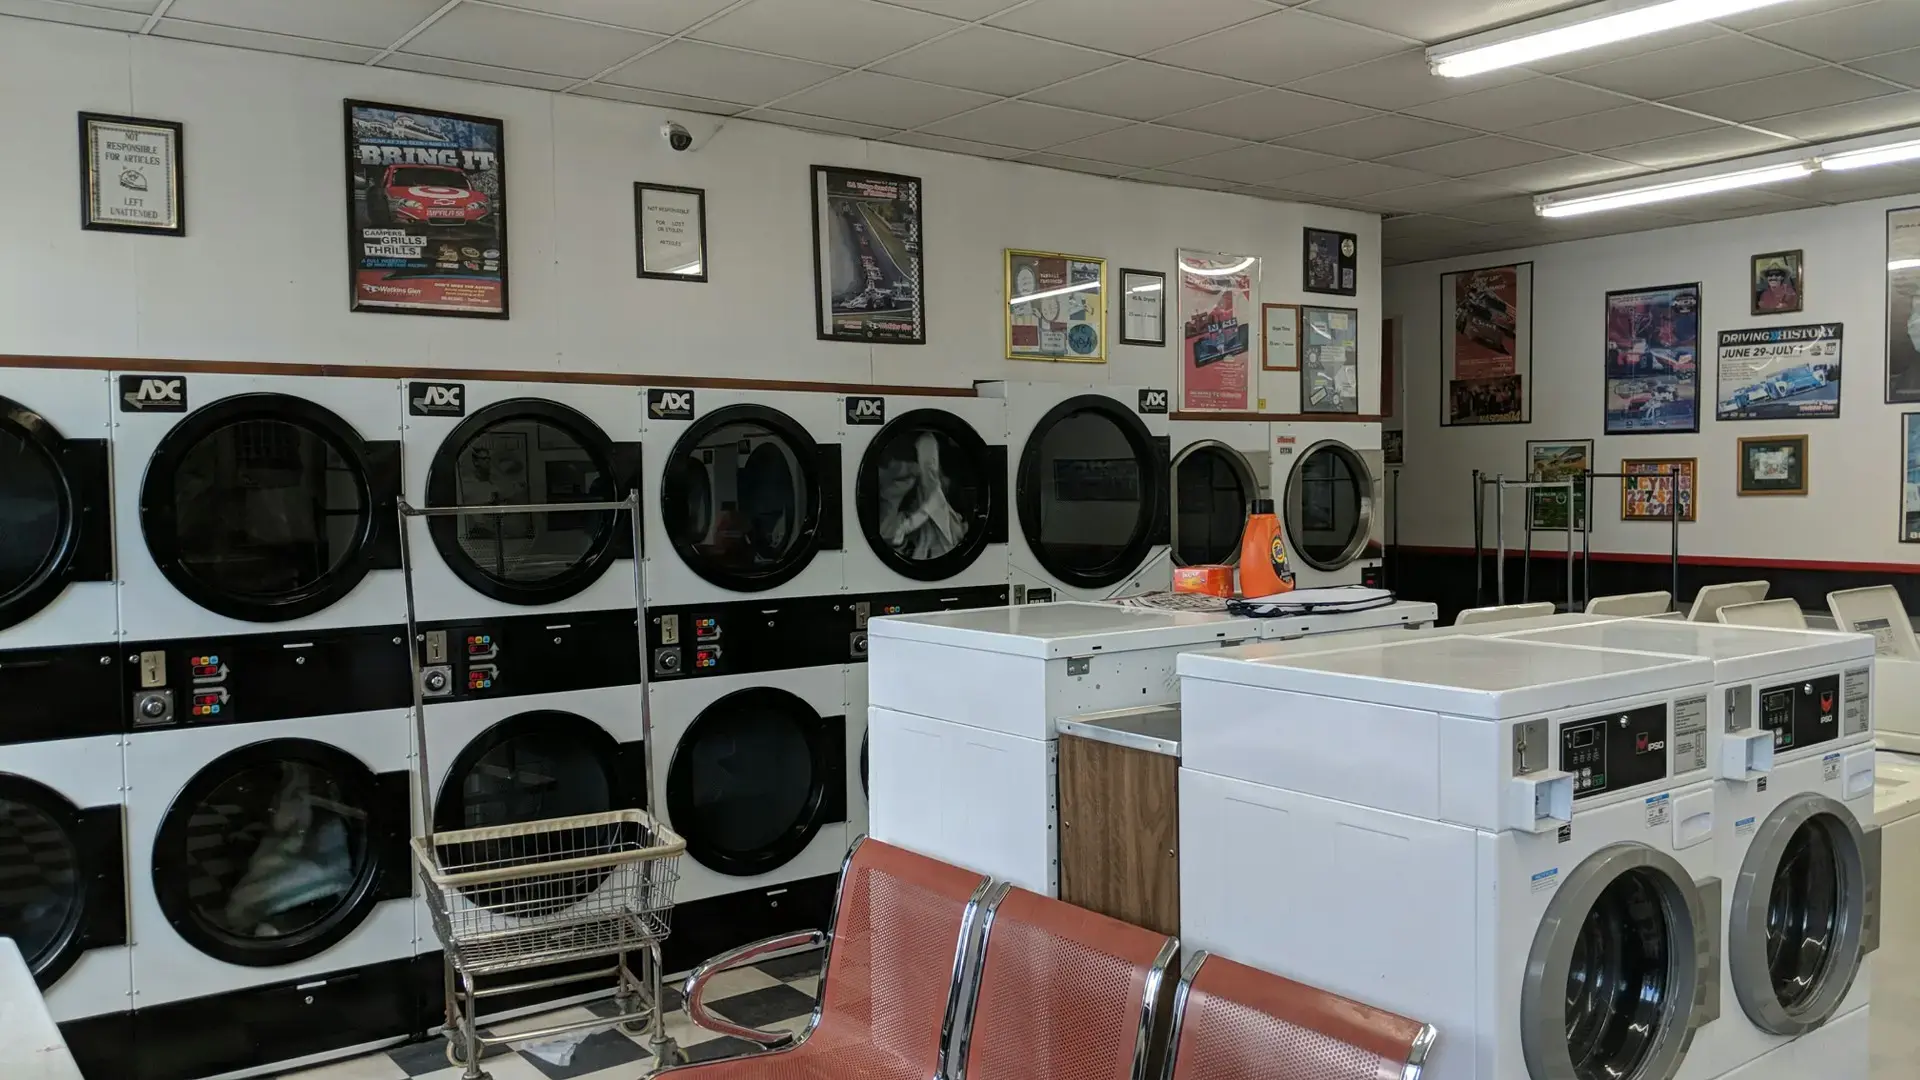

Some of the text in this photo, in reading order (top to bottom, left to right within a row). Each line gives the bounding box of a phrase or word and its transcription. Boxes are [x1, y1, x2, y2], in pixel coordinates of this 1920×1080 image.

[125, 132, 139, 141] NOT
[106, 141, 157, 154] RESPONSIBLE
[105, 152, 160, 165] FOR ARTICLES
[360, 145, 495, 169] BRING IT
[124, 198, 143, 206] LEFT
[110, 207, 157, 218] UNATTENDED
[381, 236, 426, 245] GRILLS.
[366, 245, 420, 256] THRILLS.
[1722, 326, 1836, 344] DRIVING HISTORY
[1722, 348, 1750, 359] JUNE
[1753, 345, 1795, 357] 29-JULY
[137, 379, 181, 400] ADC
[424, 386, 460, 406] ADC
[660, 392, 690, 410] ADC
[1146, 391, 1166, 406] ADC
[856, 399, 881, 416] ADC
[1820, 714, 1833, 724] IPSO
[1647, 740, 1664, 752] IPSO
